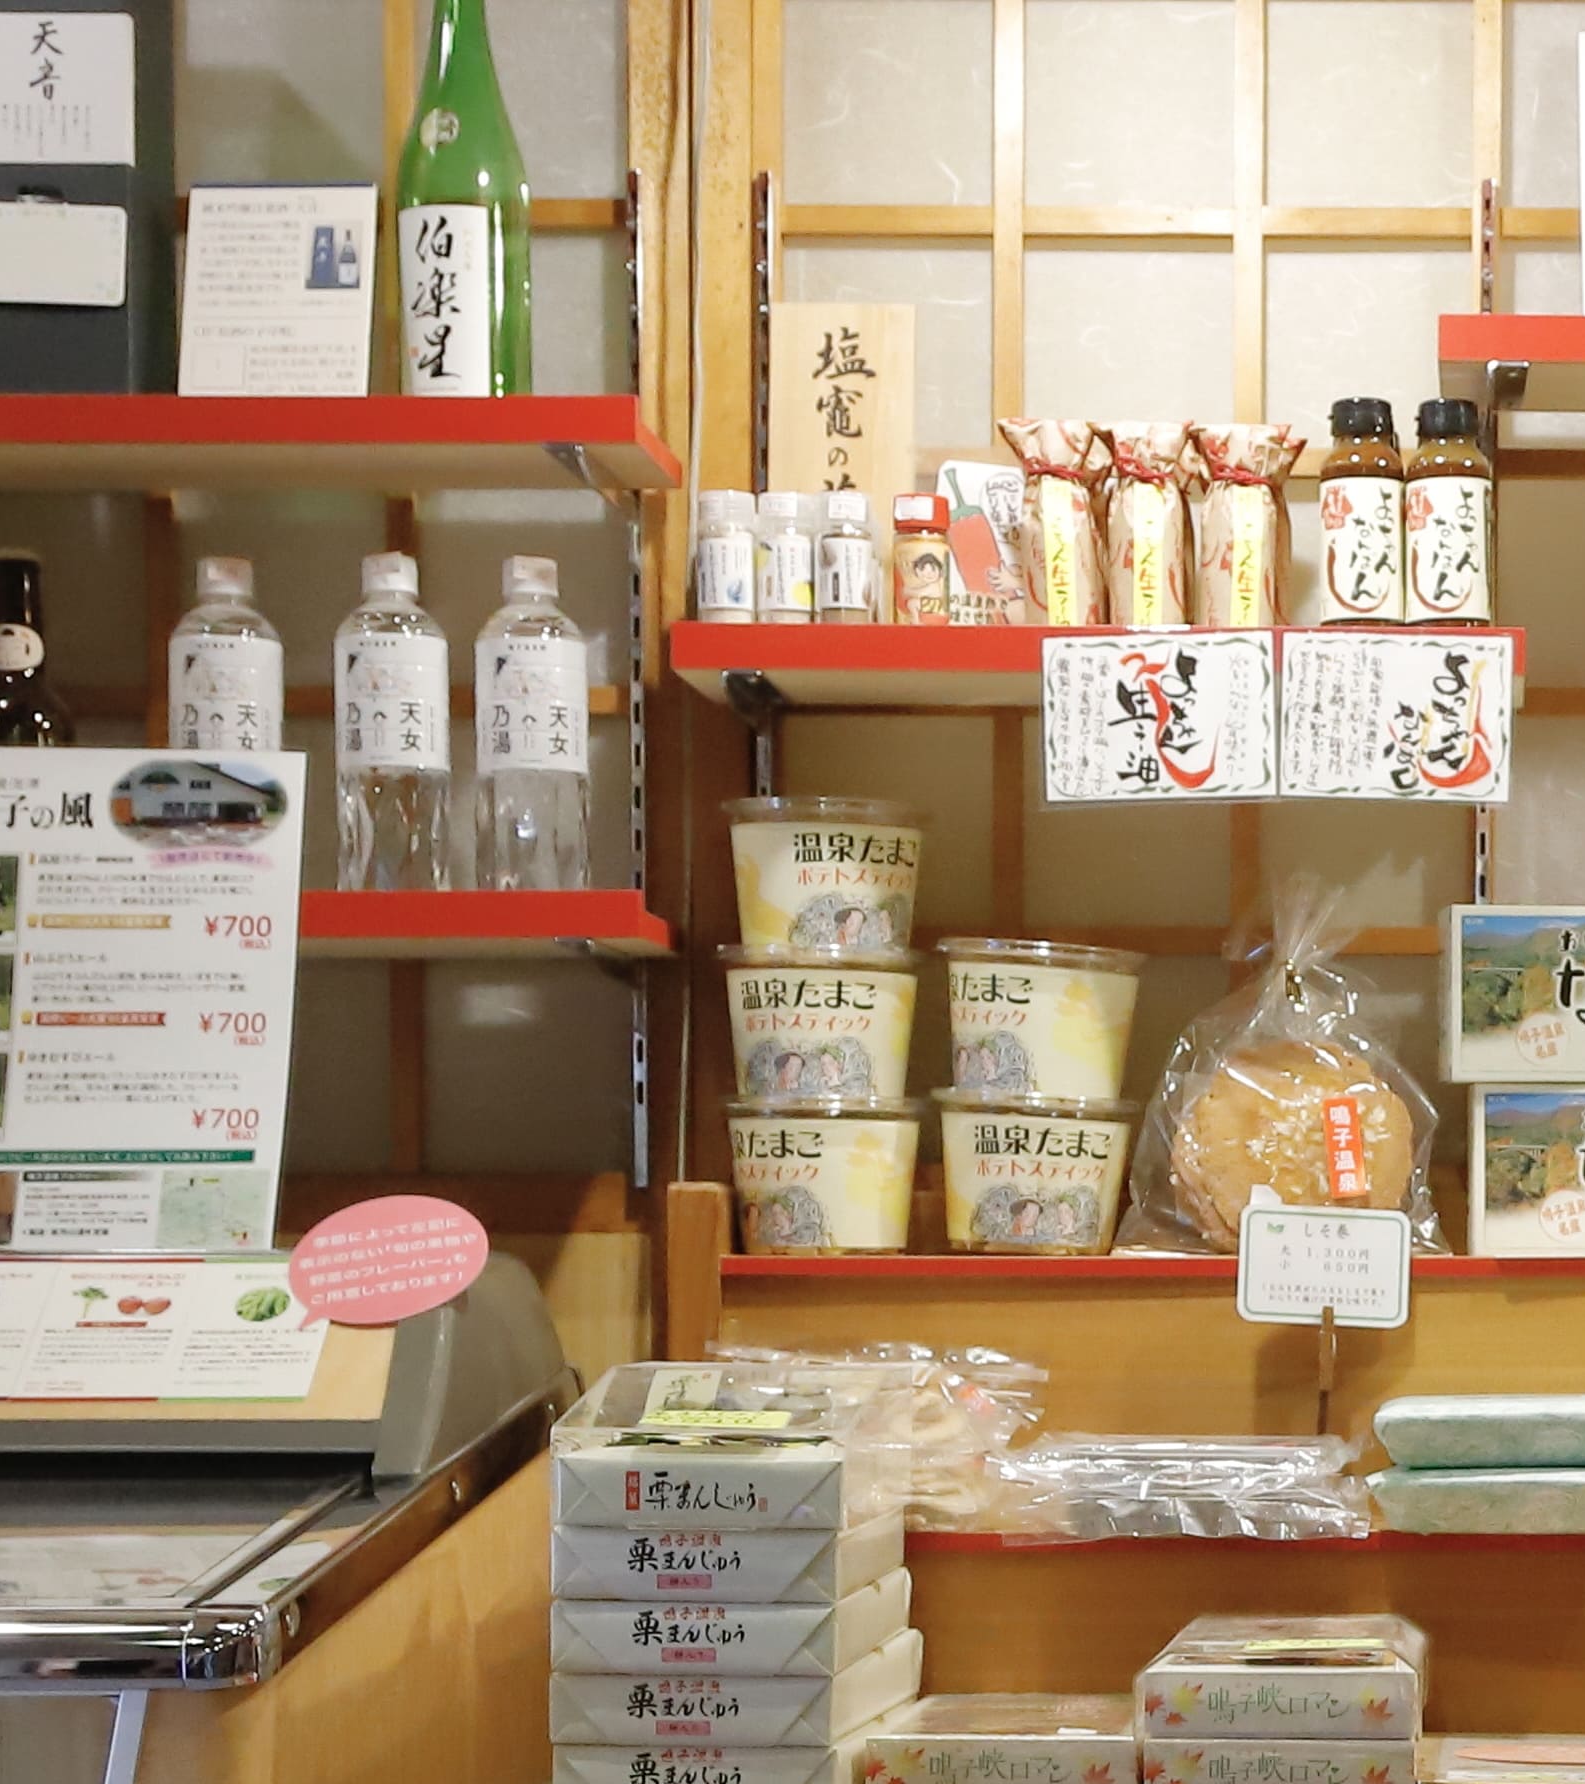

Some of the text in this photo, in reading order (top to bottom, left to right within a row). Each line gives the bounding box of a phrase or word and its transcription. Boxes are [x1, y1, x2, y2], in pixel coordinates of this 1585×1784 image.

[28, 21, 64, 99] 天音
[345, 701, 362, 752] 乃湯
[399, 701, 423, 752] 天女
[491, 704, 510, 756] 乃湯
[548, 706, 571, 757] 天女
[205, 915, 272, 937] ¥700
[740, 978, 877, 1011] 温泉たまご
[200, 1013, 266, 1034] ¥700
[745, 1013, 871, 1033] ポテトスティック
[192, 1108, 259, 1130] ¥700
[974, 1124, 1113, 1158] 温泉たまご
[1329, 1105, 1358, 1192] 鳴子温泉
[976, 1160, 1106, 1181] ポテトスティック
[1304, 1223, 1350, 1239] しそ巻
[1279, 1259, 1369, 1274] 小 650円
[644, 1471, 756, 1512] 栗まんじゅう
[627, 1537, 741, 1572] 栗まんじゅう
[632, 1611, 745, 1645] 栗まんじゅう
[627, 1684, 740, 1720] 栗まんじゅう
[1208, 1683, 1350, 1724] 鳴子峡ロマン
